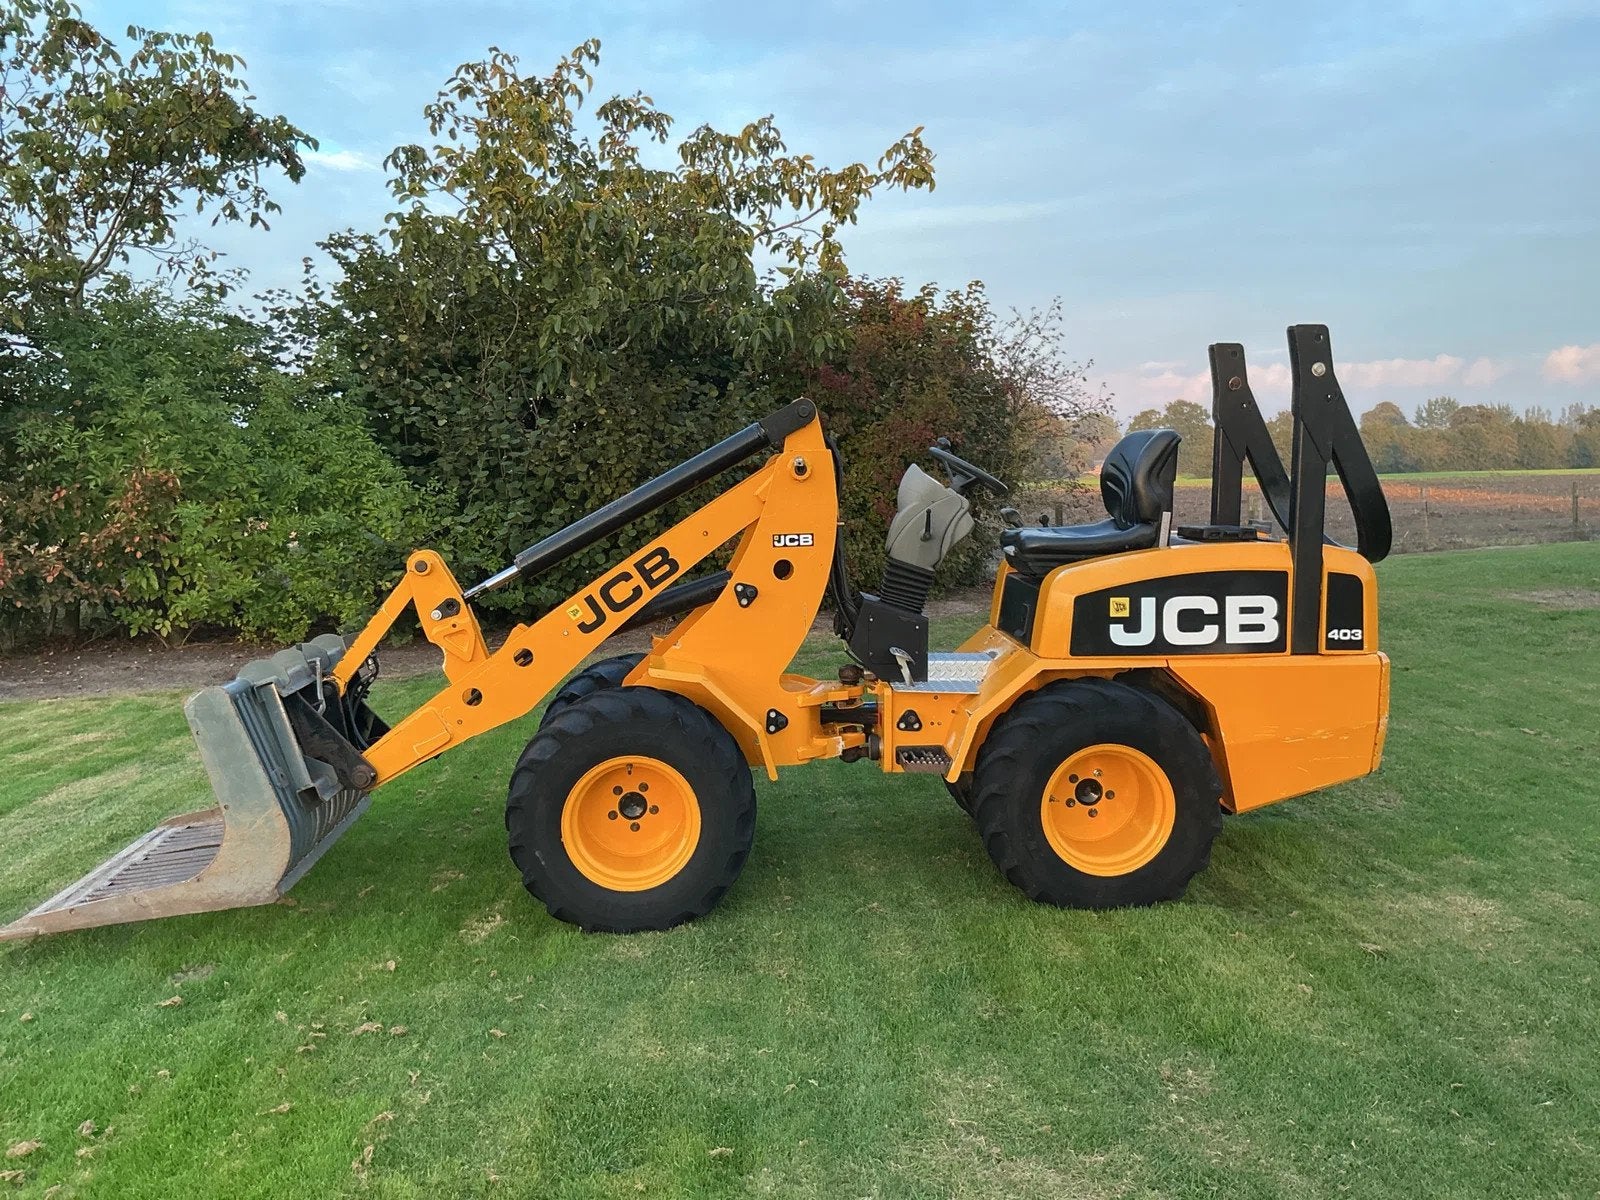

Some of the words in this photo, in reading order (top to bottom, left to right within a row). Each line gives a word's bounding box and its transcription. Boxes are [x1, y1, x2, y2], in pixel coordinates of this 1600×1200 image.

[773, 534, 813, 547] JCB
[577, 547, 680, 634] JCB
[1109, 596, 1279, 646] JCB
[1328, 629, 1363, 640] 403
